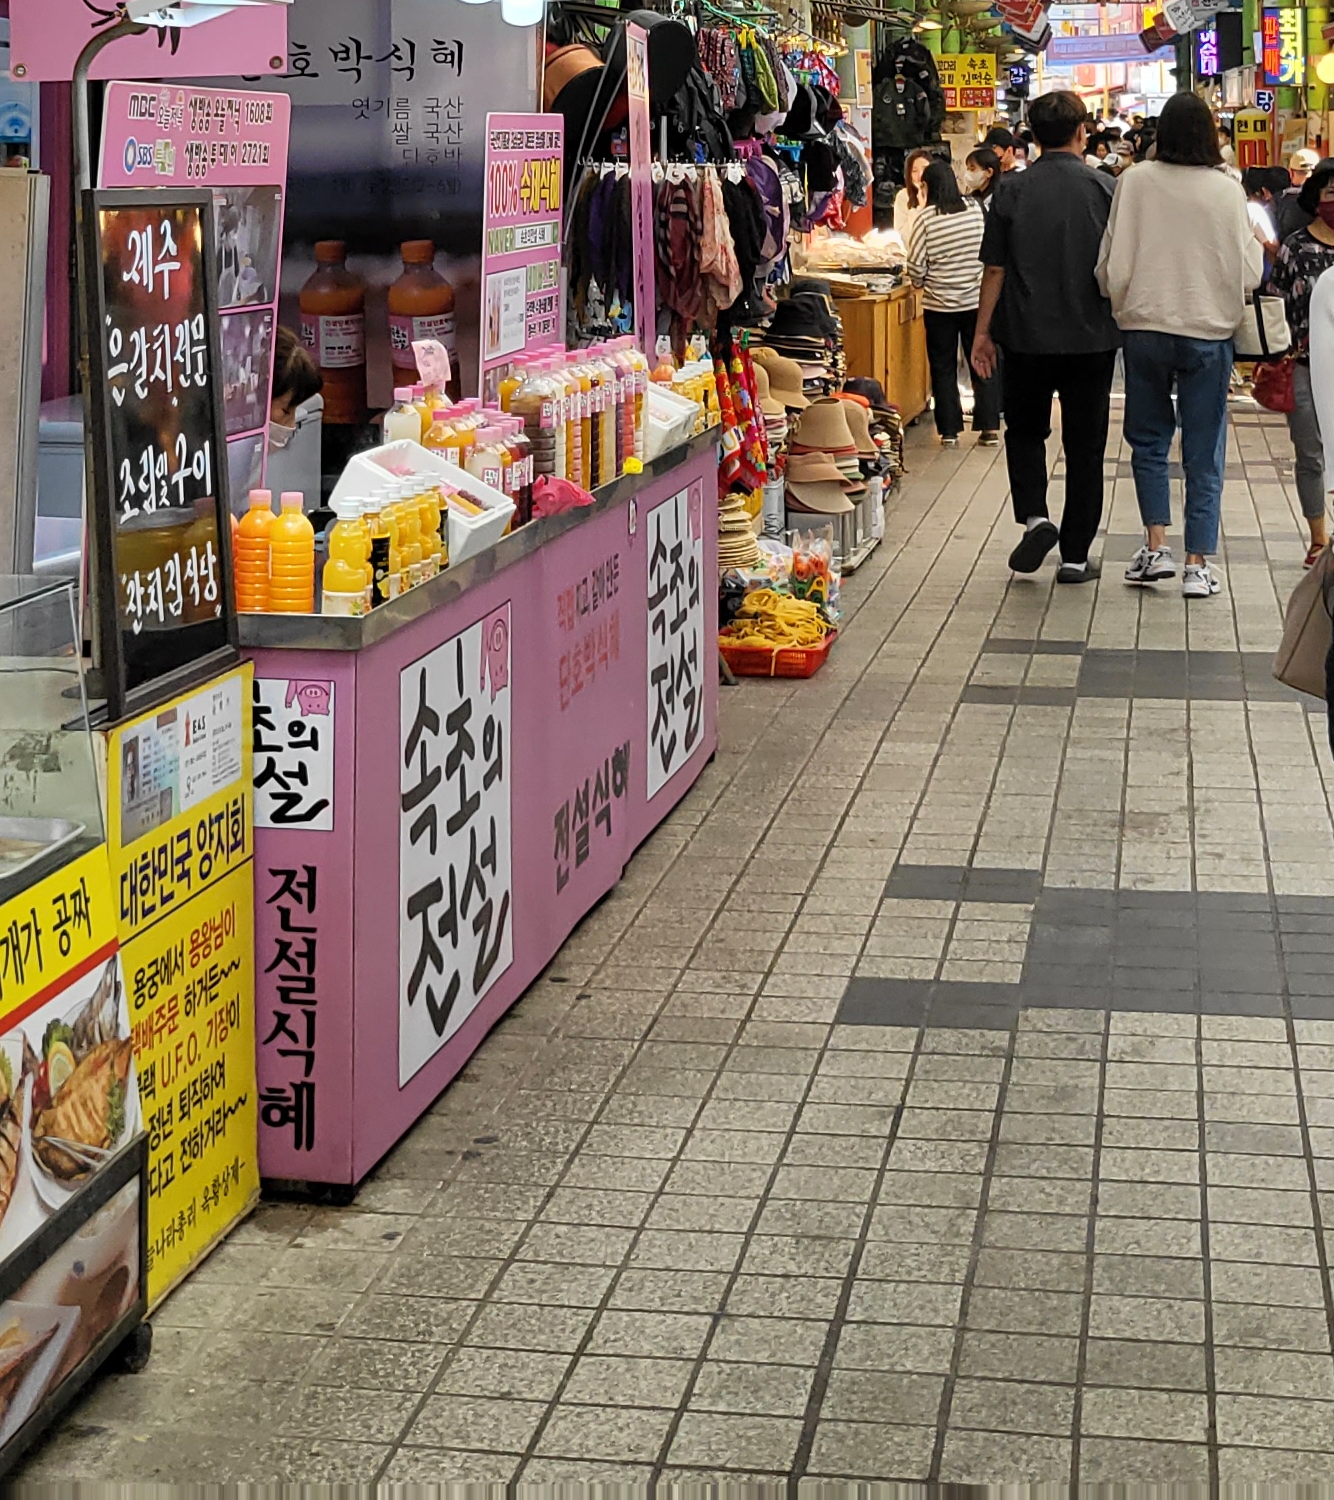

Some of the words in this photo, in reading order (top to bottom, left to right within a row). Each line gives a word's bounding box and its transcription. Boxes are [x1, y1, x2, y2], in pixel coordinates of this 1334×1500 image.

[242, 36, 465, 85] 호박식혜
[128, 93, 157, 119] MBC
[352, 97, 412, 120] 엿기름
[423, 96, 464, 120] 국산
[391, 122, 413, 146] 쌀
[423, 121, 464, 145] 국산
[489, 159, 518, 219] 100%
[519, 154, 561, 216] 수제식혜
[122, 218, 182, 300] 제주
[646, 498, 702, 647] 속초의
[252, 680, 319, 754] 초의
[650, 626, 703, 776] 전설
[400, 636, 504, 857] 속초의
[253, 759, 329, 824] 설
[119, 826, 193, 927] 대한민국
[196, 791, 246, 881] 양지회
[51, 876, 94, 957] 공짜
[133, 937, 186, 1011] 용궁에서
[189, 900, 237, 970] 용왕님이
[407, 815, 510, 1037] 전설
[258, 863, 319, 1152] 전설식혜
[148, 1096, 174, 1153] 정년
[178, 1051, 227, 1121] 퇴직하여
